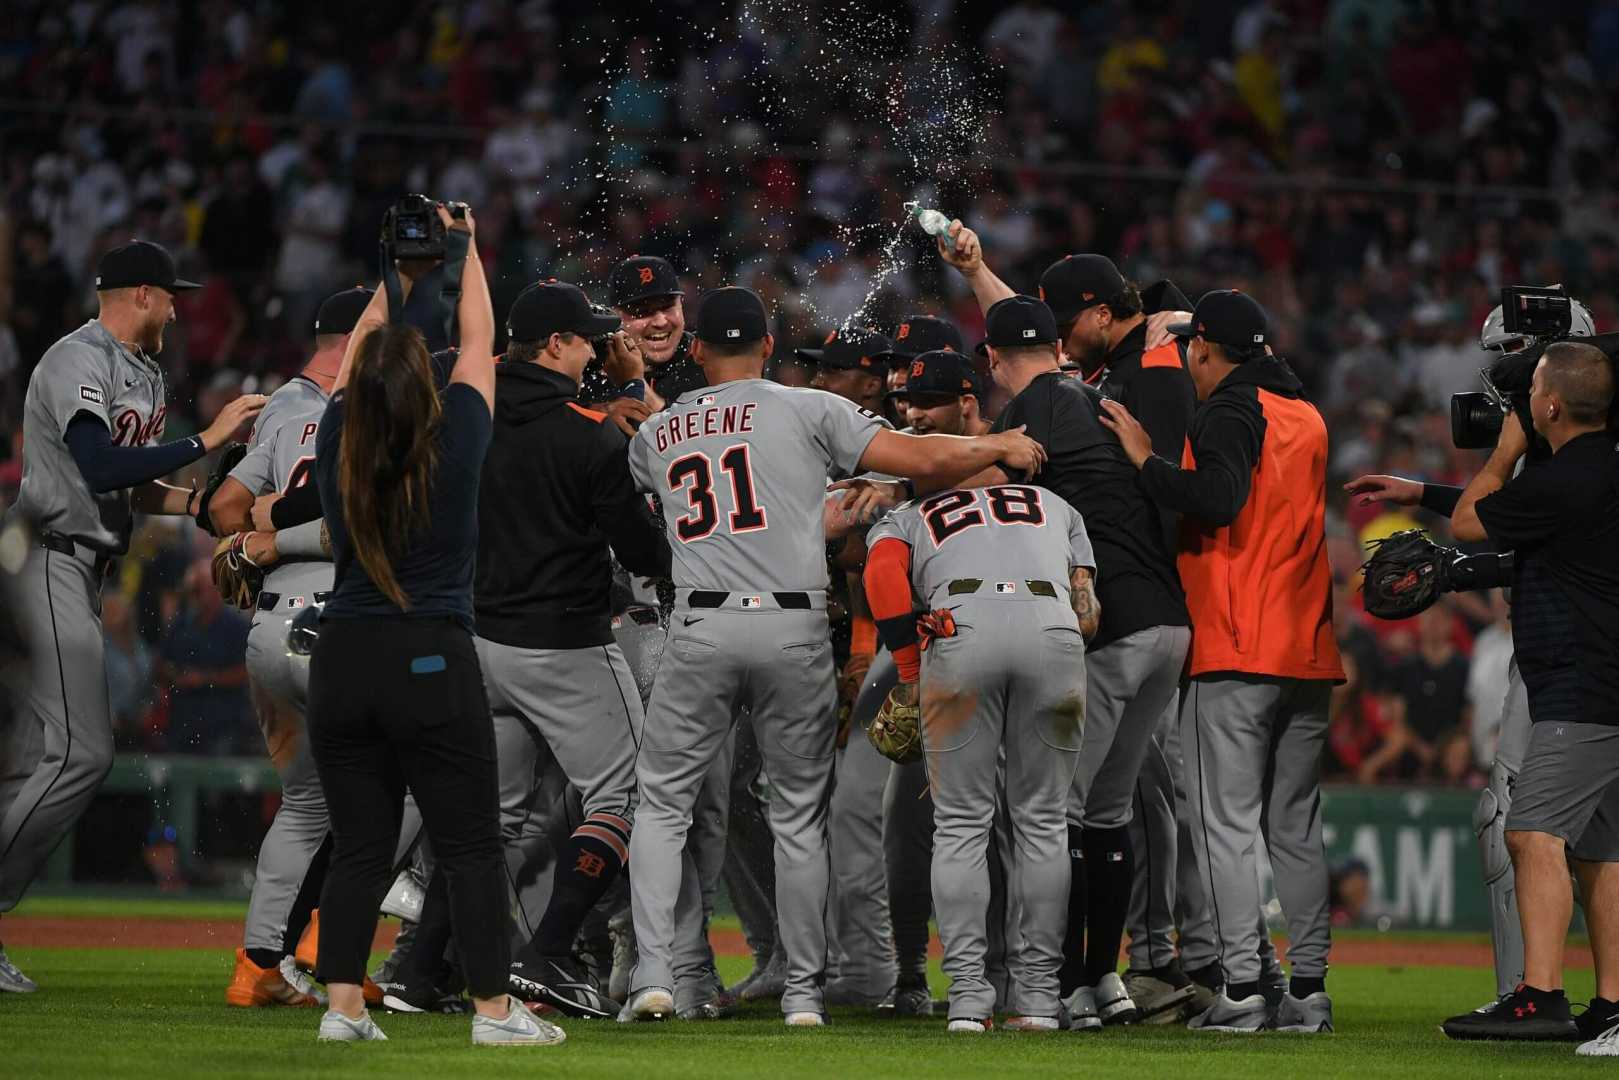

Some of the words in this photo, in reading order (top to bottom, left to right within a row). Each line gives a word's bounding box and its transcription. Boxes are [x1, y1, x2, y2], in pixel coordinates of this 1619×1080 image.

[299, 421, 319, 447] P
[655, 402, 758, 455] GREENE
[666, 442, 769, 544] 31
[918, 483, 1047, 551] 28
[1323, 823, 1456, 928] AM
